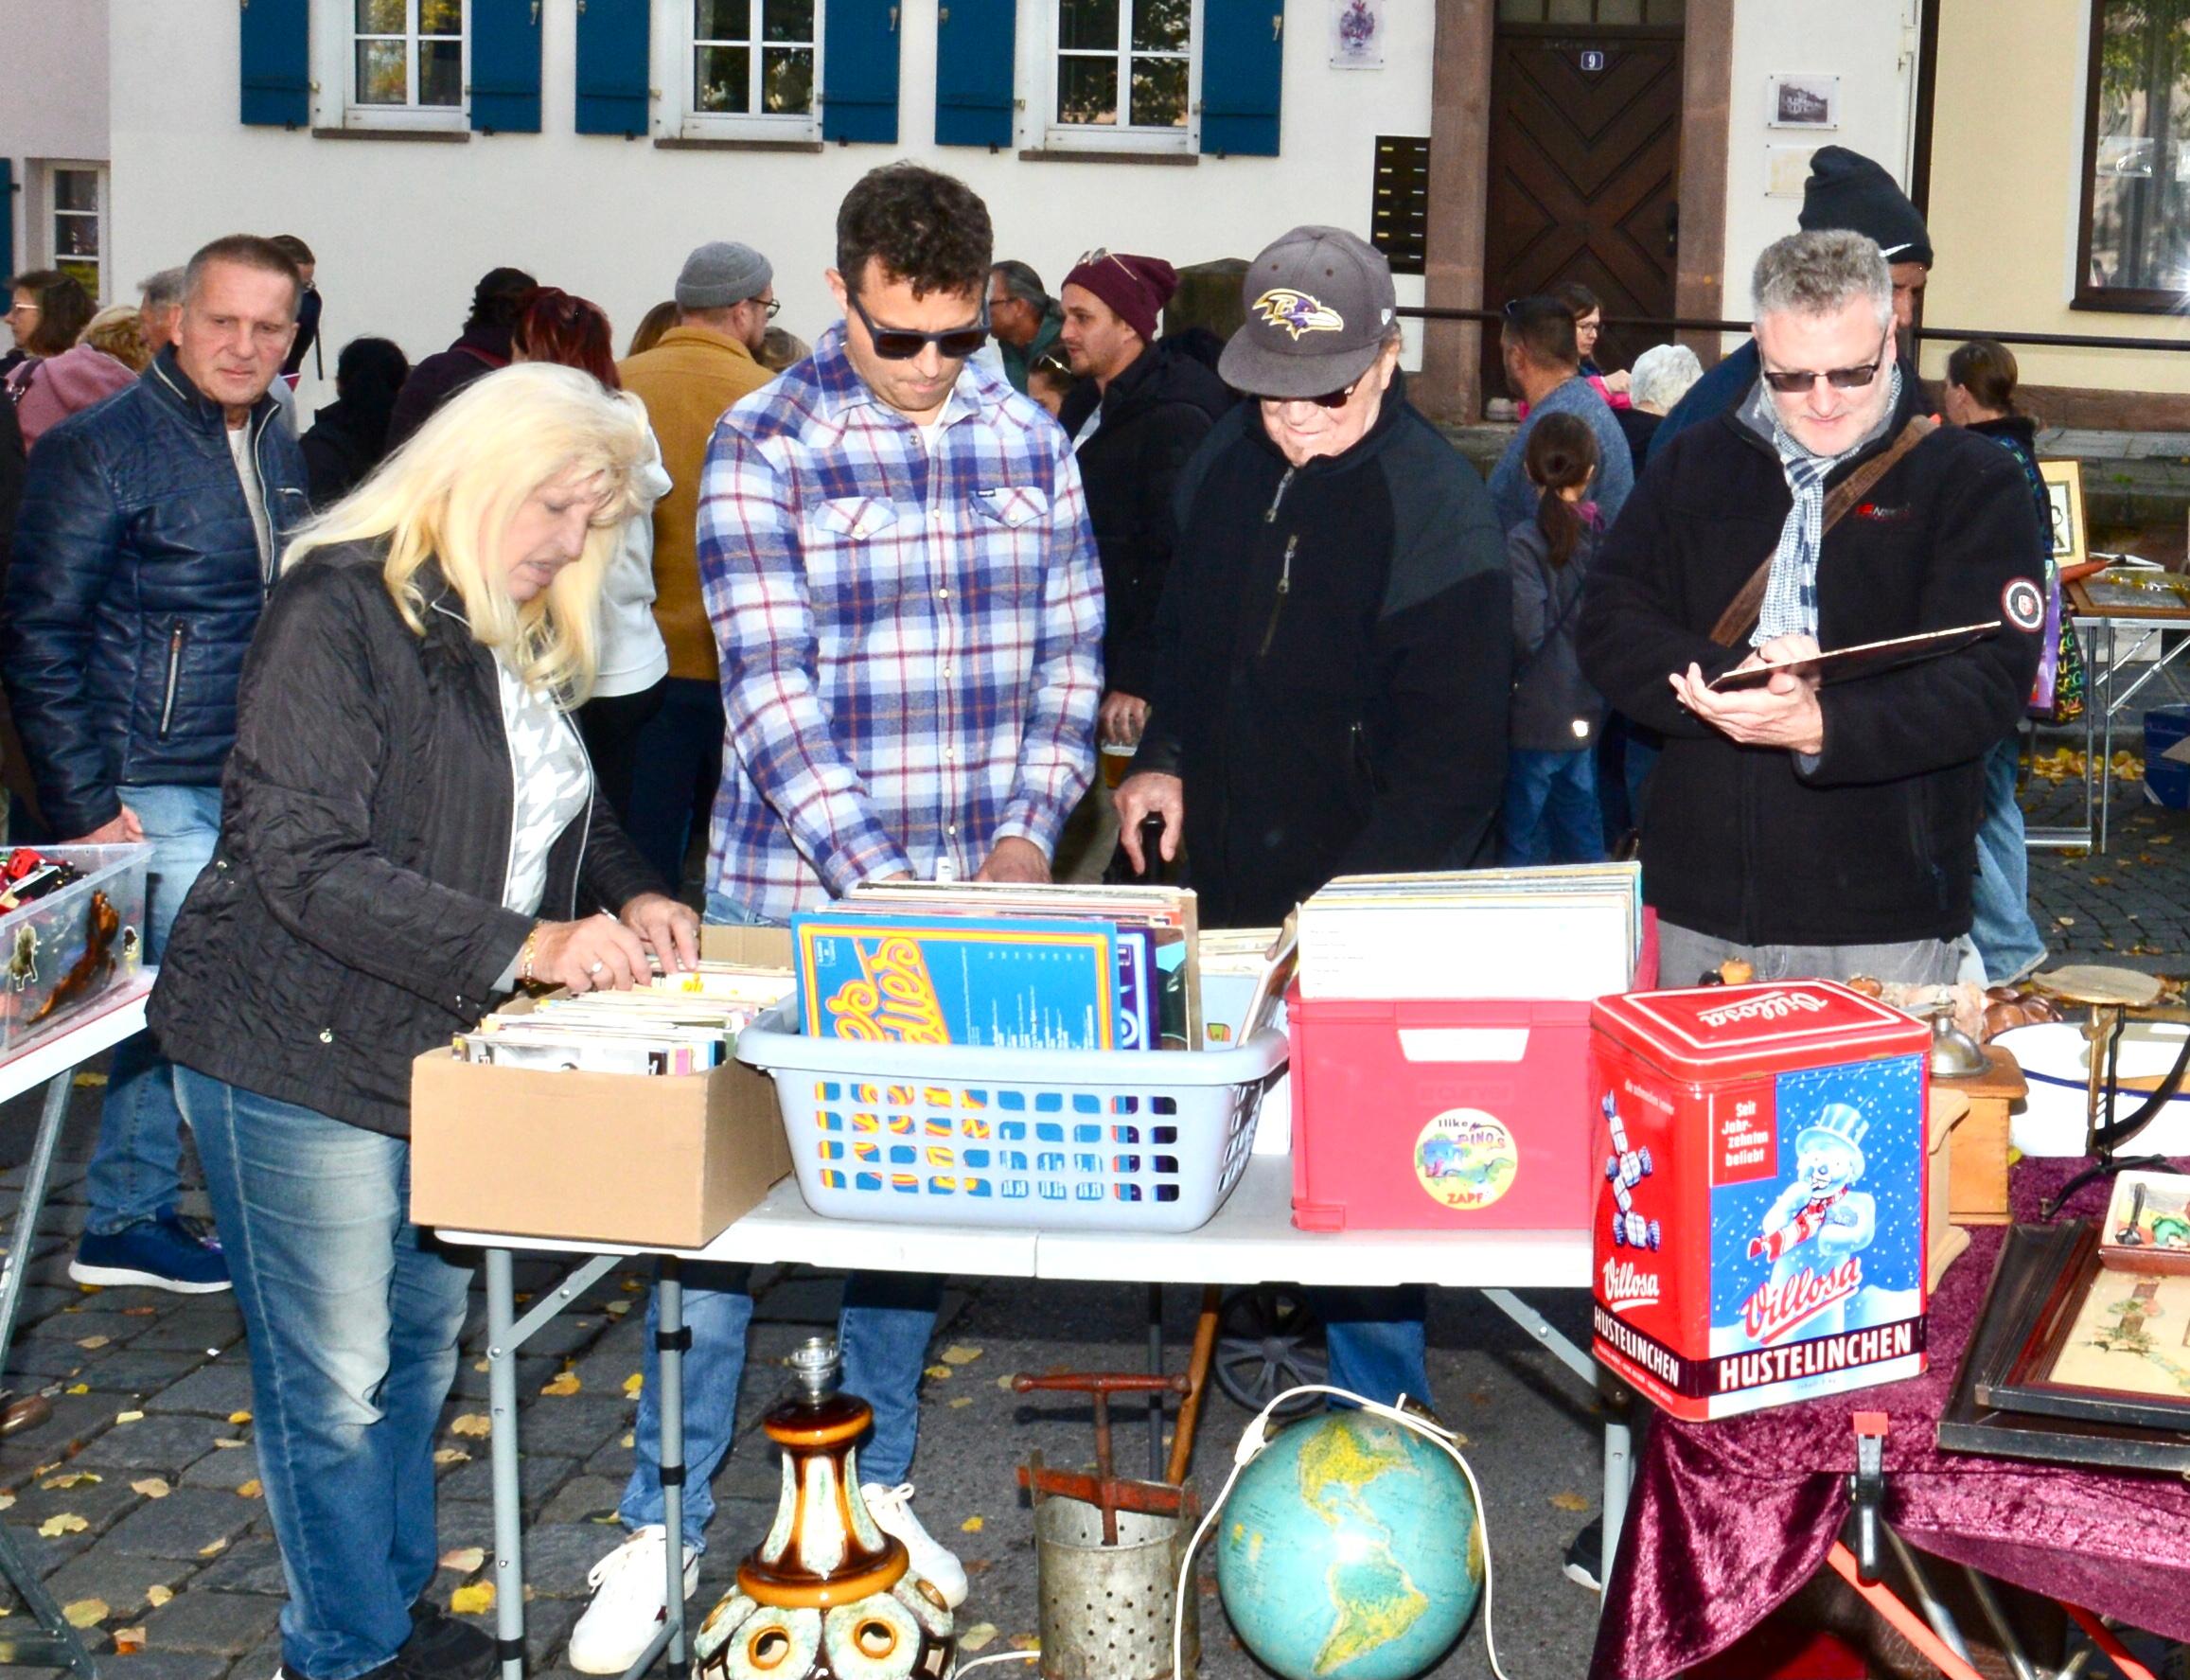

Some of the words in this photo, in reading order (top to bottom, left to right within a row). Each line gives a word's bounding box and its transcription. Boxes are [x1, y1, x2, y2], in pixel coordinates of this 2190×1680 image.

[1588, 54, 1596, 69] 9
[1699, 992, 1828, 1027] Villosa
[1736, 1100, 1757, 1118] Seit
[1444, 1119, 1468, 1128] like
[1722, 1119, 1753, 1136] Jahr-
[1727, 1131, 1769, 1149] zehnten
[1725, 1147, 1765, 1167] beliebt
[1447, 1193, 1484, 1204] ZAPF
[1603, 1256, 1660, 1301] Villosa
[1741, 1257, 1862, 1341] Villosa
[1594, 1304, 1680, 1388] HUSTELINCHEN
[1719, 1322, 1912, 1392] HUSTELINCHEN
